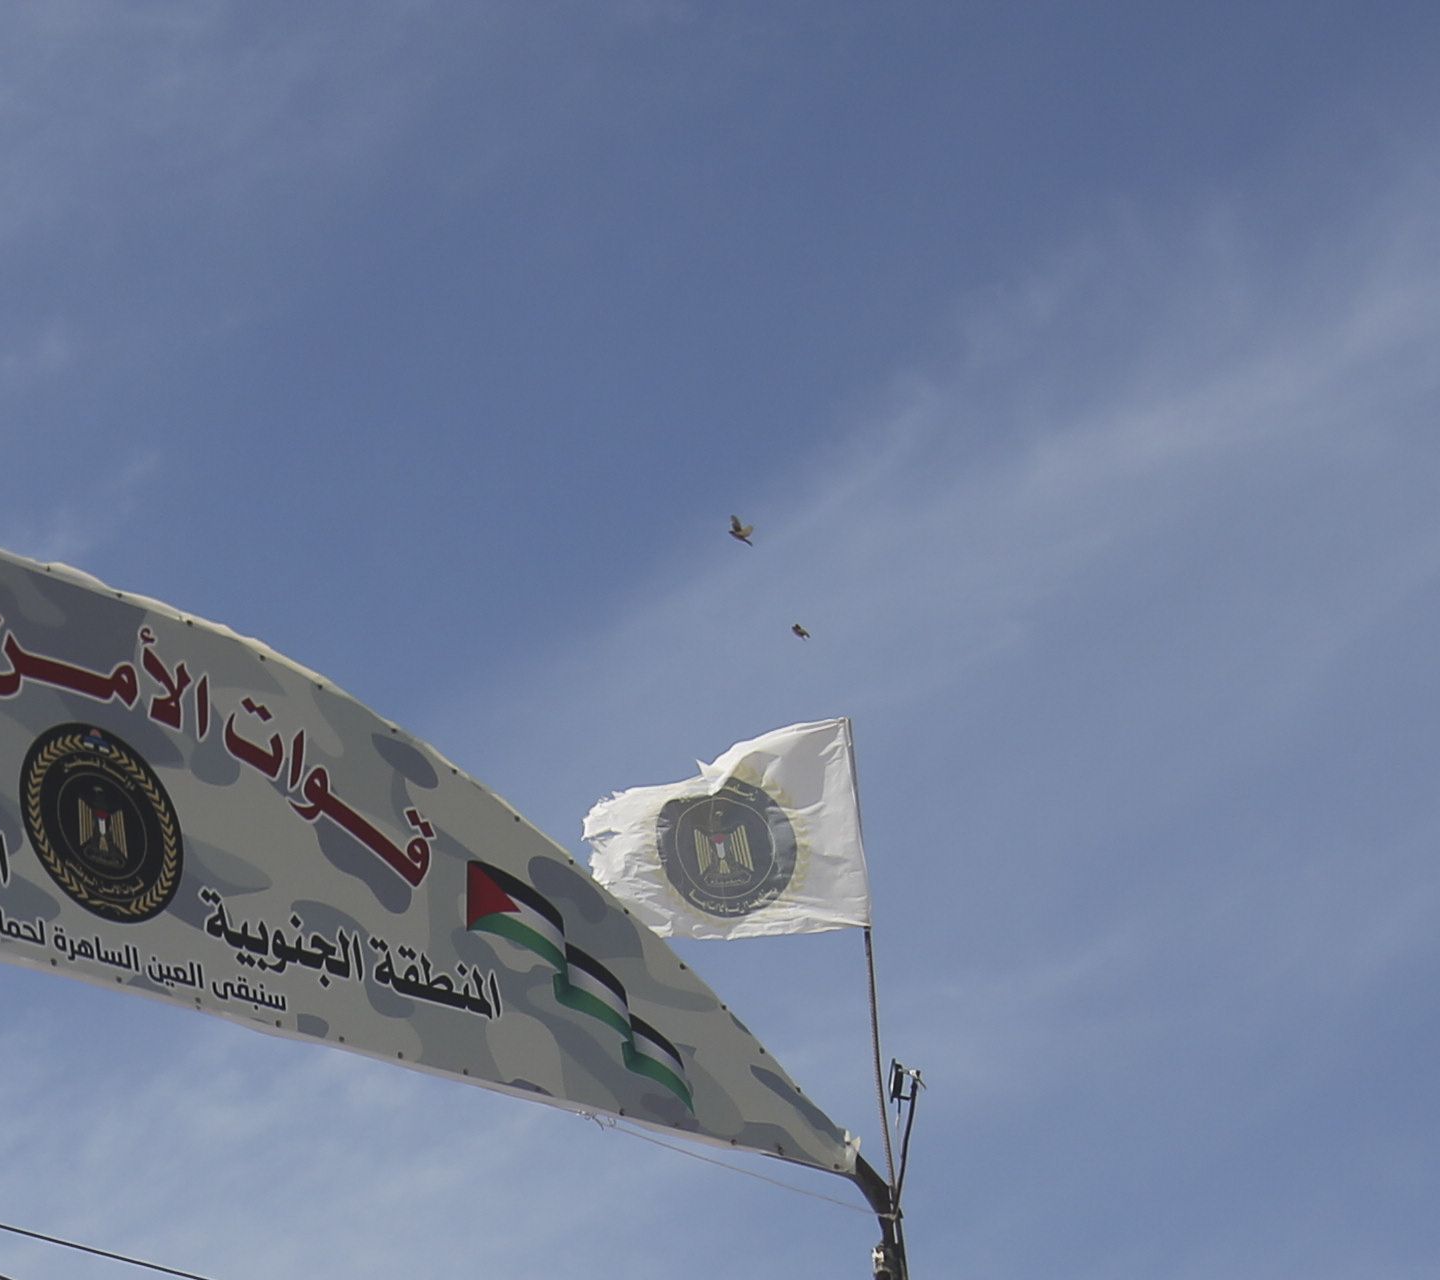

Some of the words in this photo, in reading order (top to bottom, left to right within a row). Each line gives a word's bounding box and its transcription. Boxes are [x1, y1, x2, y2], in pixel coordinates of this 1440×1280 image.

[224, 697, 437, 888] قوات
[54, 928, 140, 972] الساهرة
[200, 888, 364, 988] الجنوبية
[147, 956, 204, 989] العين
[212, 976, 288, 1012] سنبقى
[368, 936, 502, 1020] المنطقة
